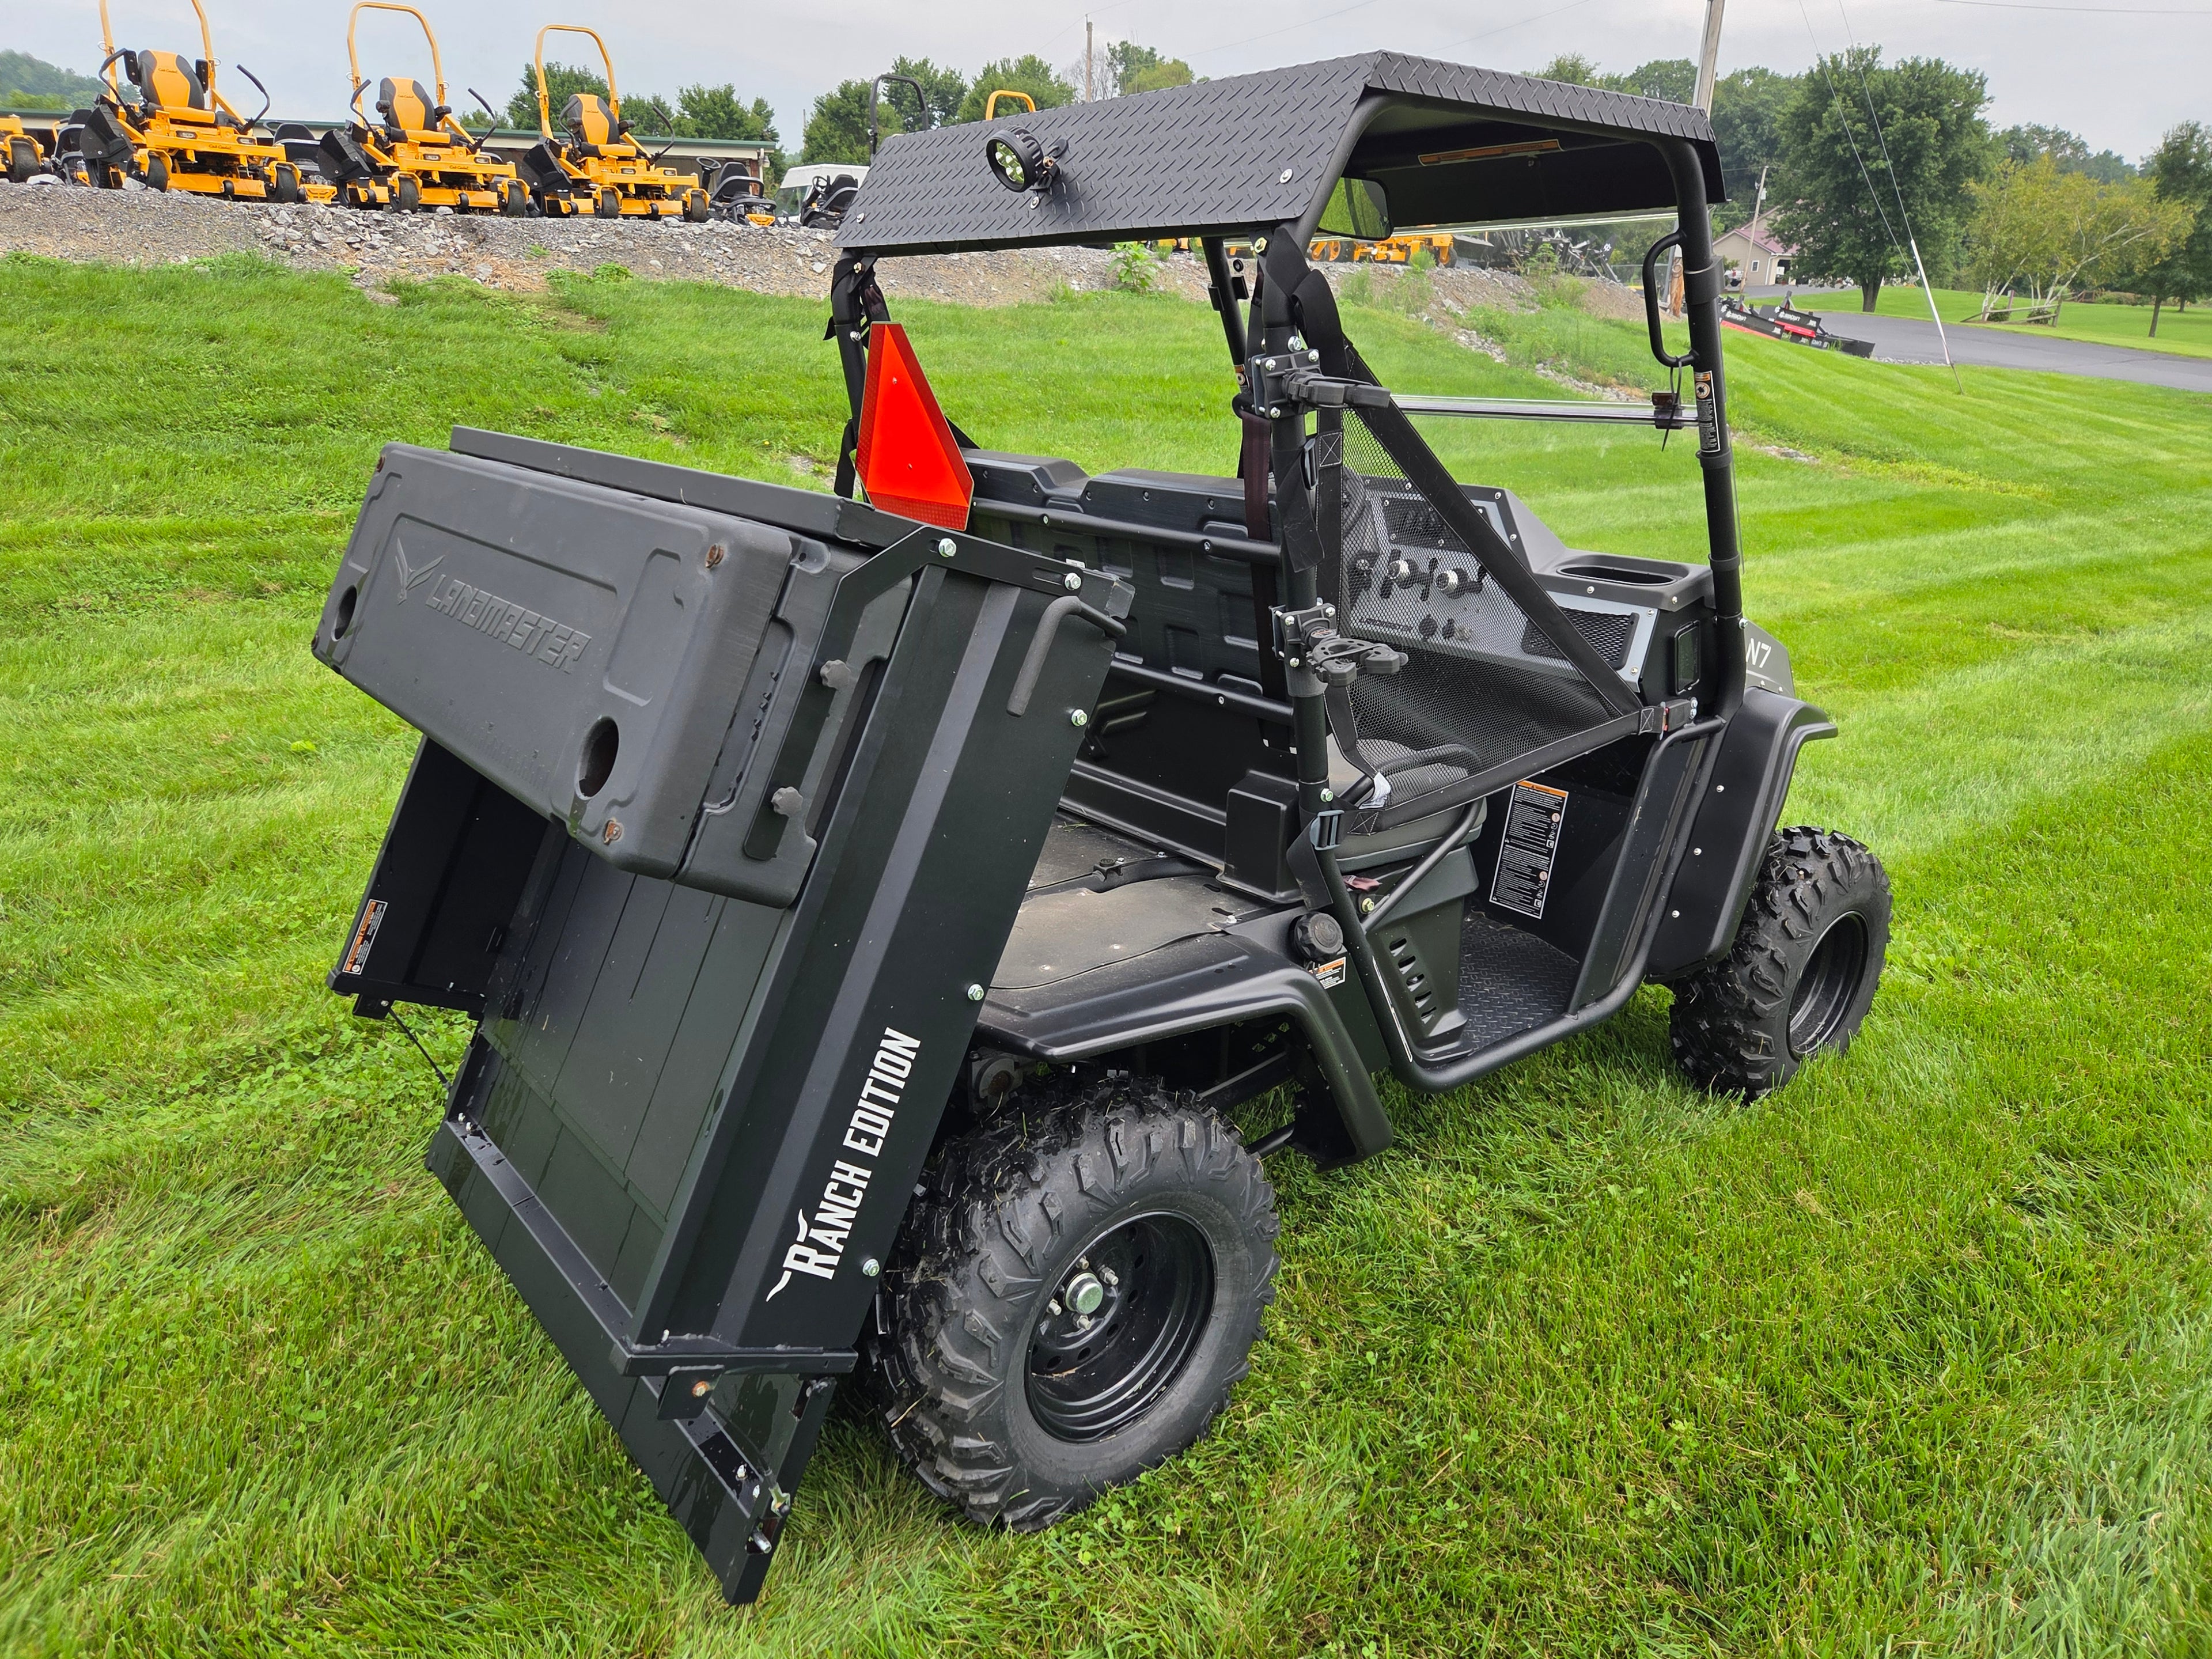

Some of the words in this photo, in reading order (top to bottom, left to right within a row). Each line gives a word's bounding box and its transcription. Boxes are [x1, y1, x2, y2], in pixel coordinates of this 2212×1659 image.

[426, 574, 592, 675] LANDMASTER
[782, 1160, 872, 1280] RANCH
[842, 1027, 921, 1157] EDITION
